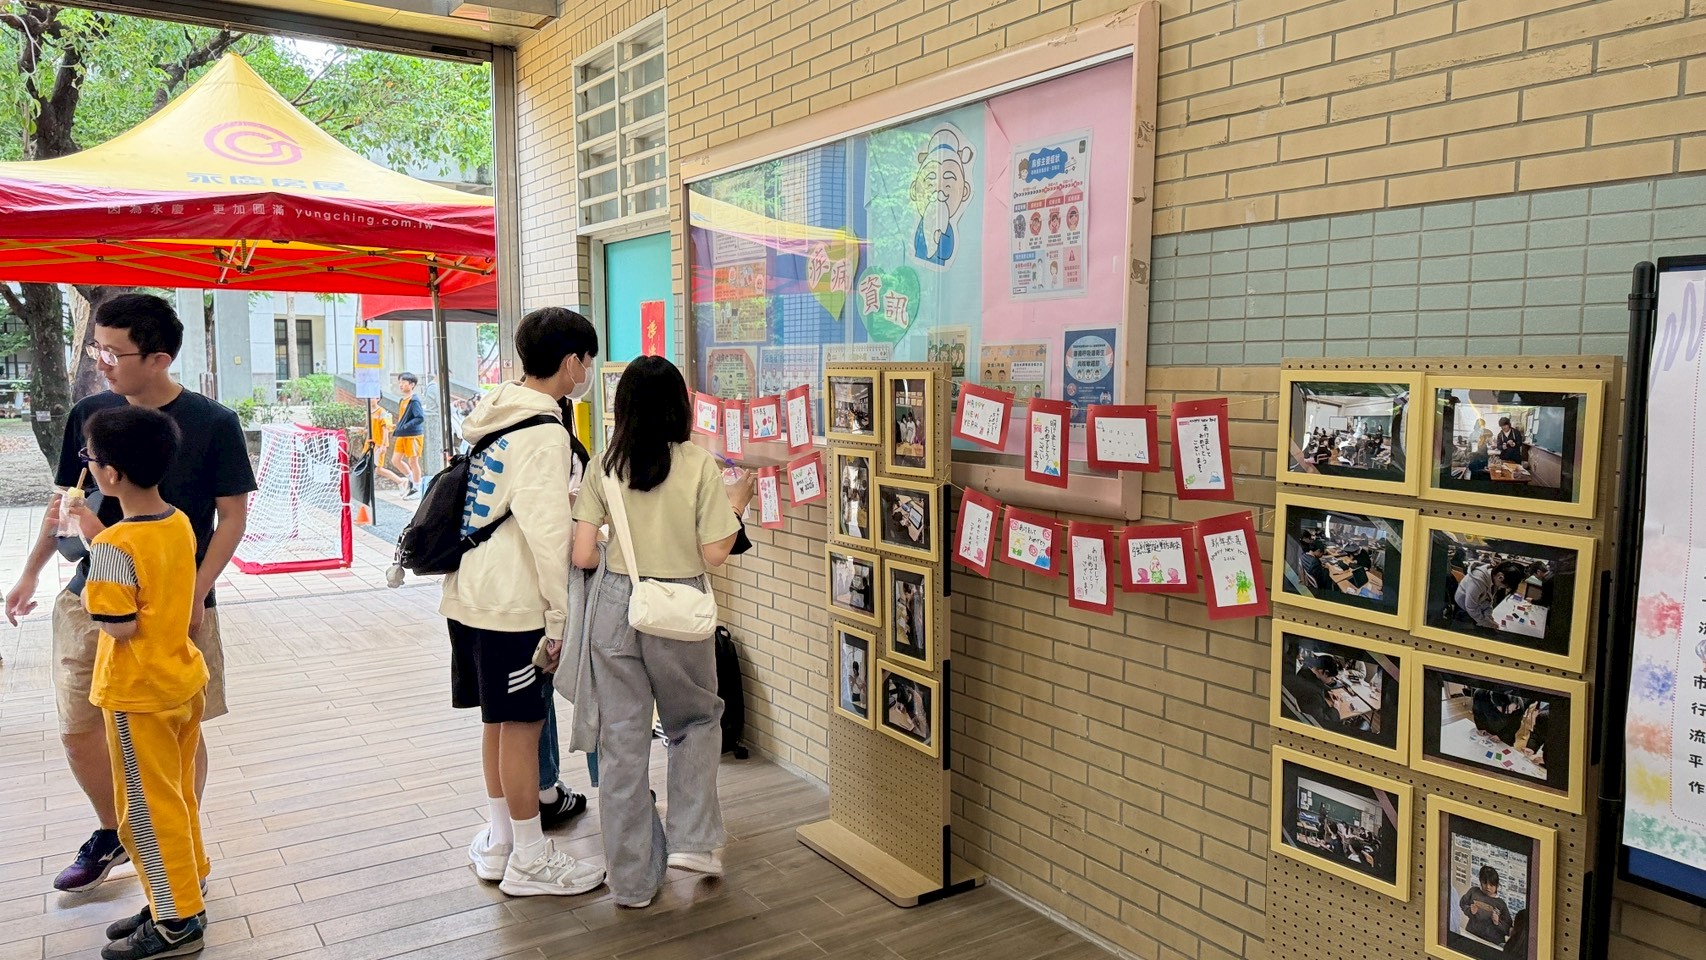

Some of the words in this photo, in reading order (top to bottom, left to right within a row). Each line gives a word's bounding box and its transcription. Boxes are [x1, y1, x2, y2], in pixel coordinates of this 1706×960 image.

[186, 172, 349, 192] 永慶房屋
[295, 208, 433, 230] yungching.com.tw
[861, 276, 907, 326] 資訊
[359, 338, 377, 354] 21
[965, 410, 979, 420] NEW
